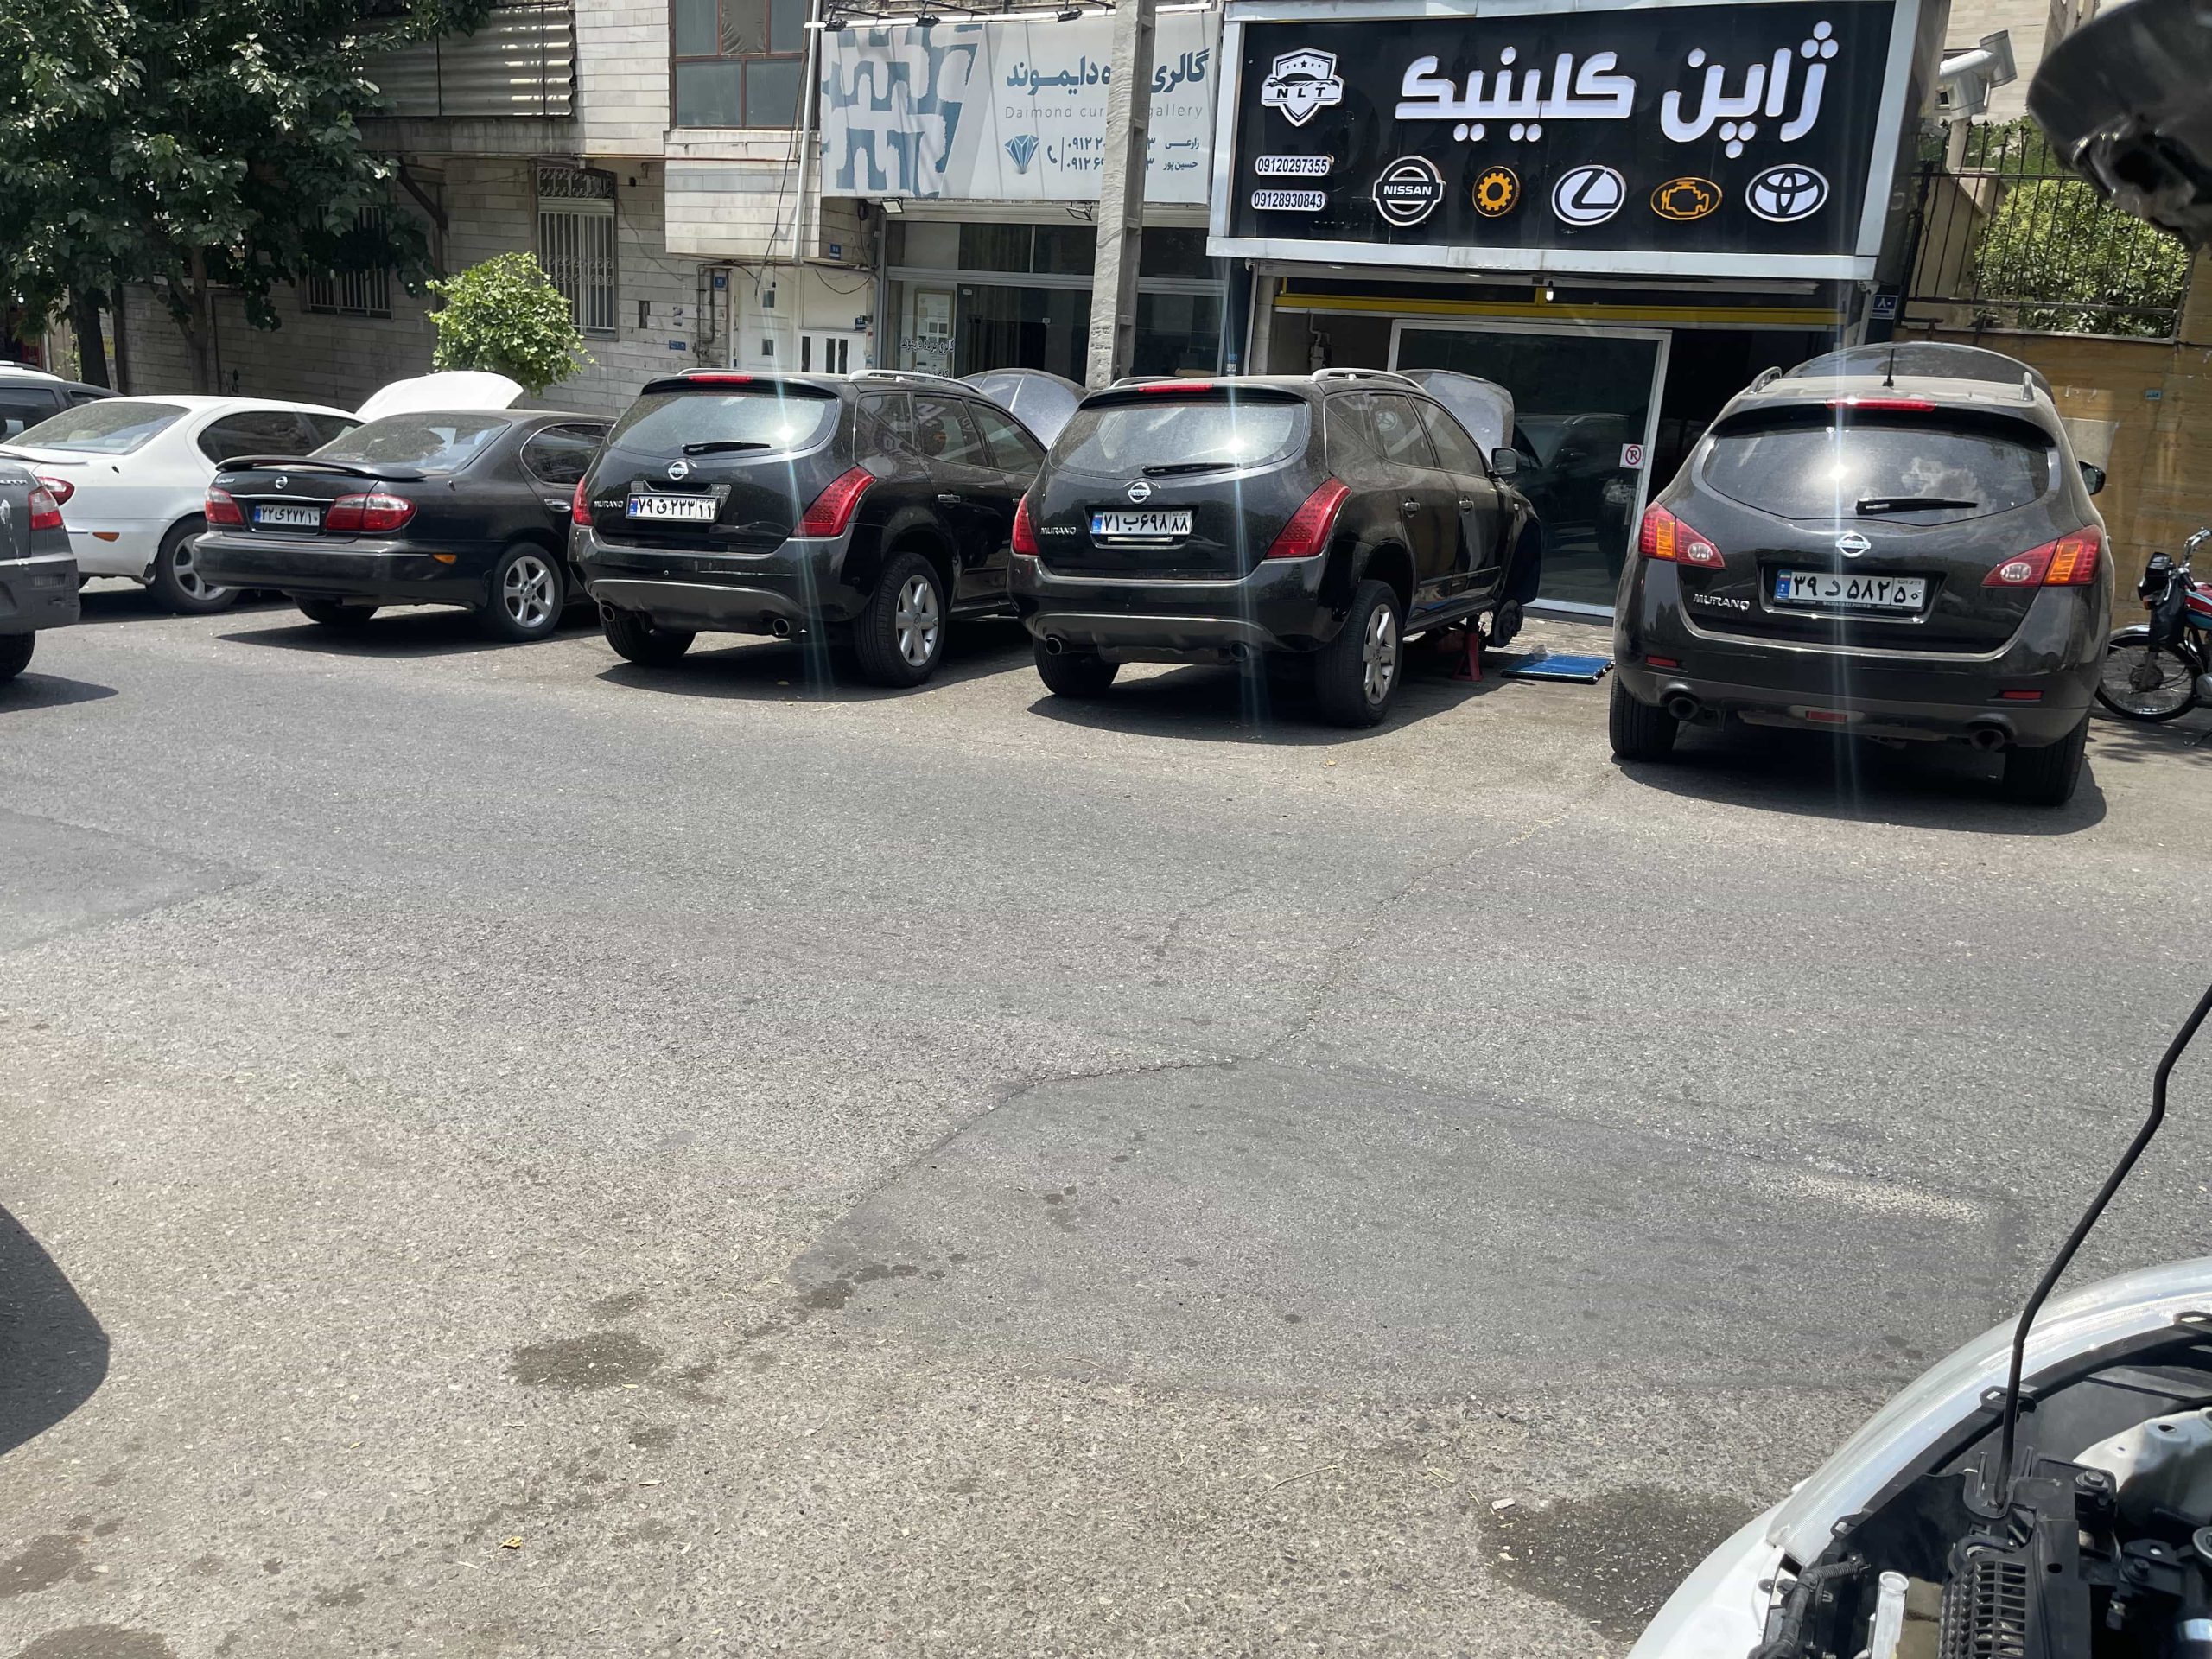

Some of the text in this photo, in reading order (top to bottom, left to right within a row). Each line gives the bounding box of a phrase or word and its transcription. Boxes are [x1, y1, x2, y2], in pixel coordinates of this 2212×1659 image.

[1007, 55, 1100, 96] دایموند
[1151, 48, 1210, 93] گالری
[1395, 20, 1840, 159] ژاپن کلینیک
[1005, 105, 1072, 118] Daimond
[1148, 104, 1203, 122] gallery
[1257, 158, 1327, 173] 09120297355
[1383, 185, 1433, 196] NISSAN
[1254, 192, 1323, 208] 09128930843
[1040, 526, 1077, 536] MURANO
[1693, 594, 1751, 611] MURANO
